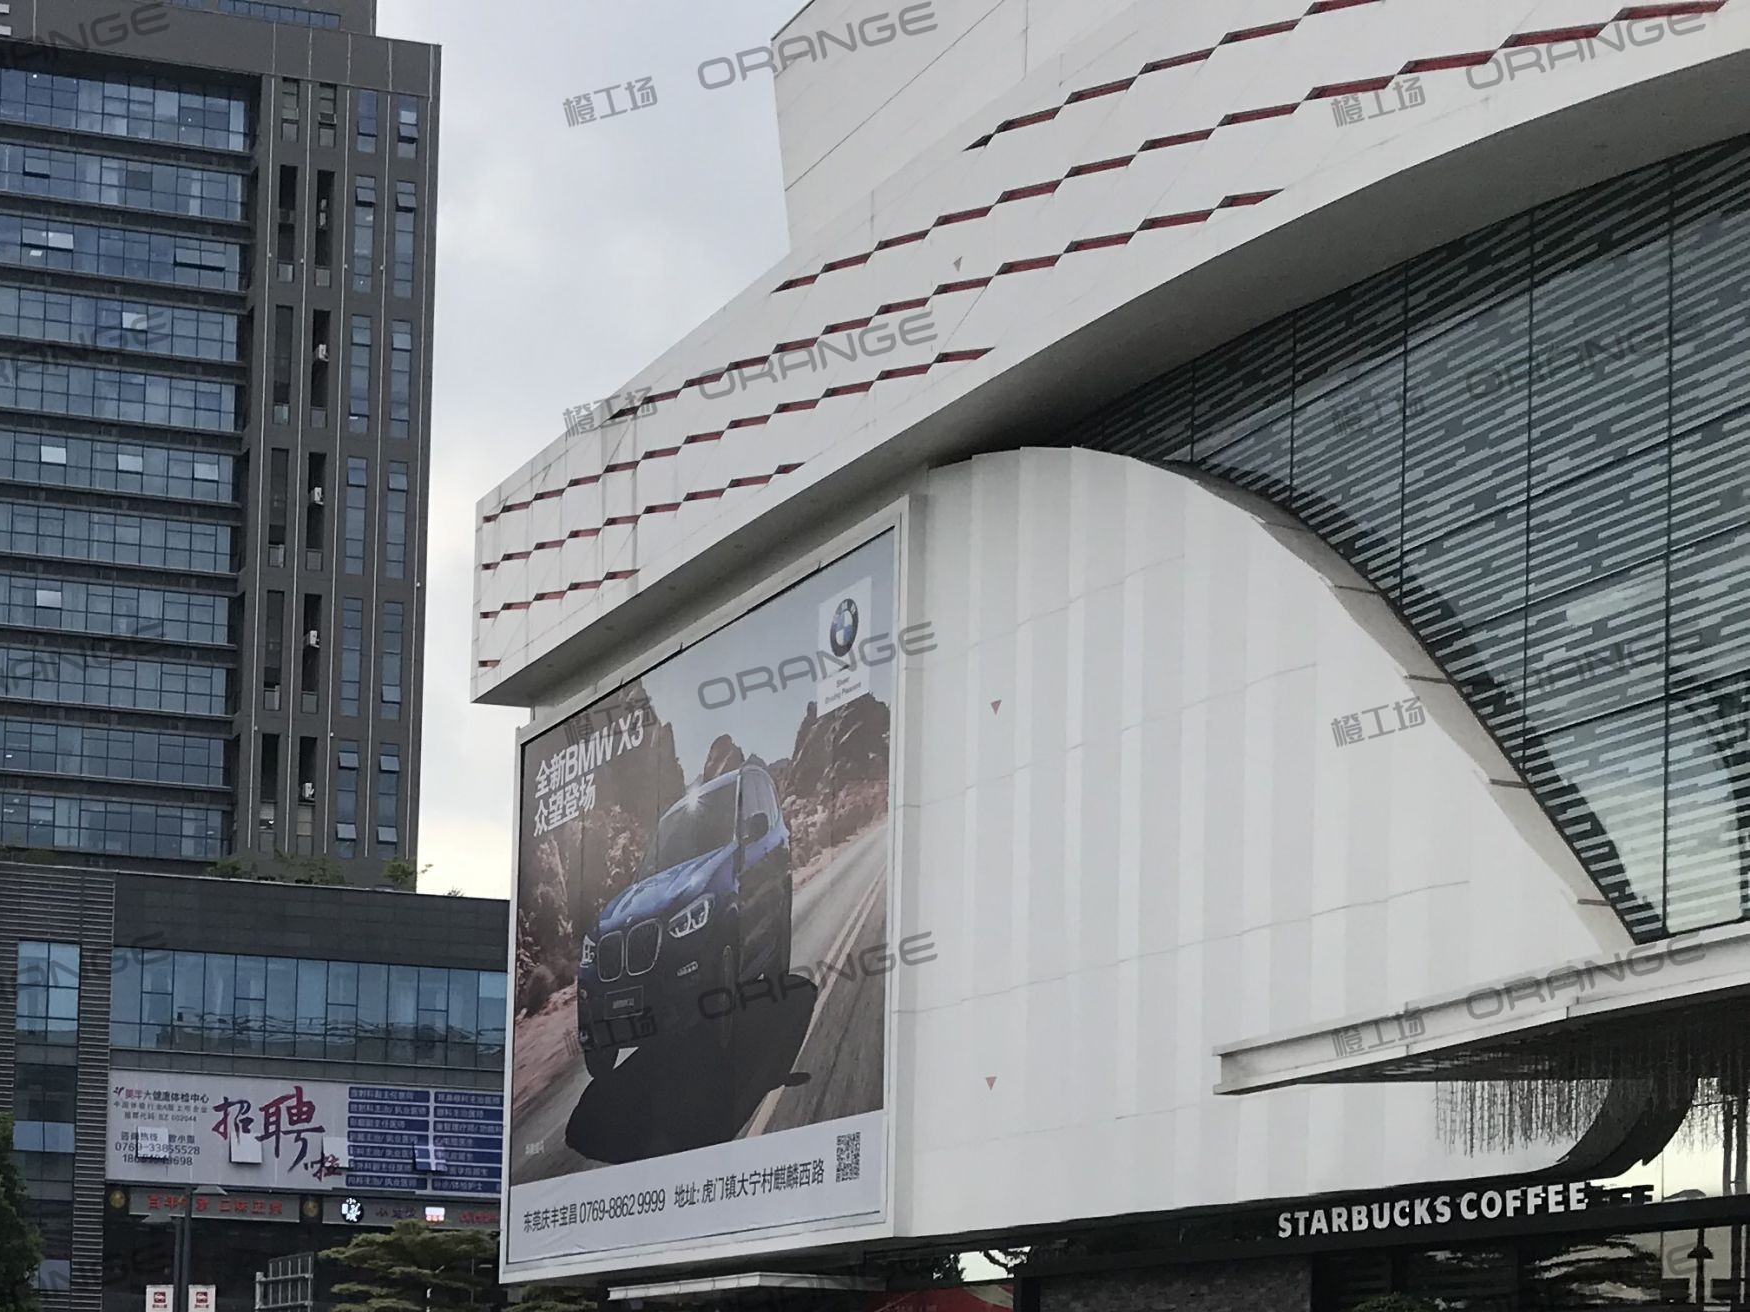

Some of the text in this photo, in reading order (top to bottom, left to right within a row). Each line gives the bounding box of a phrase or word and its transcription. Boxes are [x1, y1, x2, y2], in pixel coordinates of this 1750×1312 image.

[535, 708, 644, 799] 全新BMW X3
[533, 773, 596, 837] 众望登场
[579, 1194, 635, 1225] 0769-8862
[636, 1188, 666, 1215] 9999
[1278, 1181, 1589, 1238] STARBUCKS COFFEE
